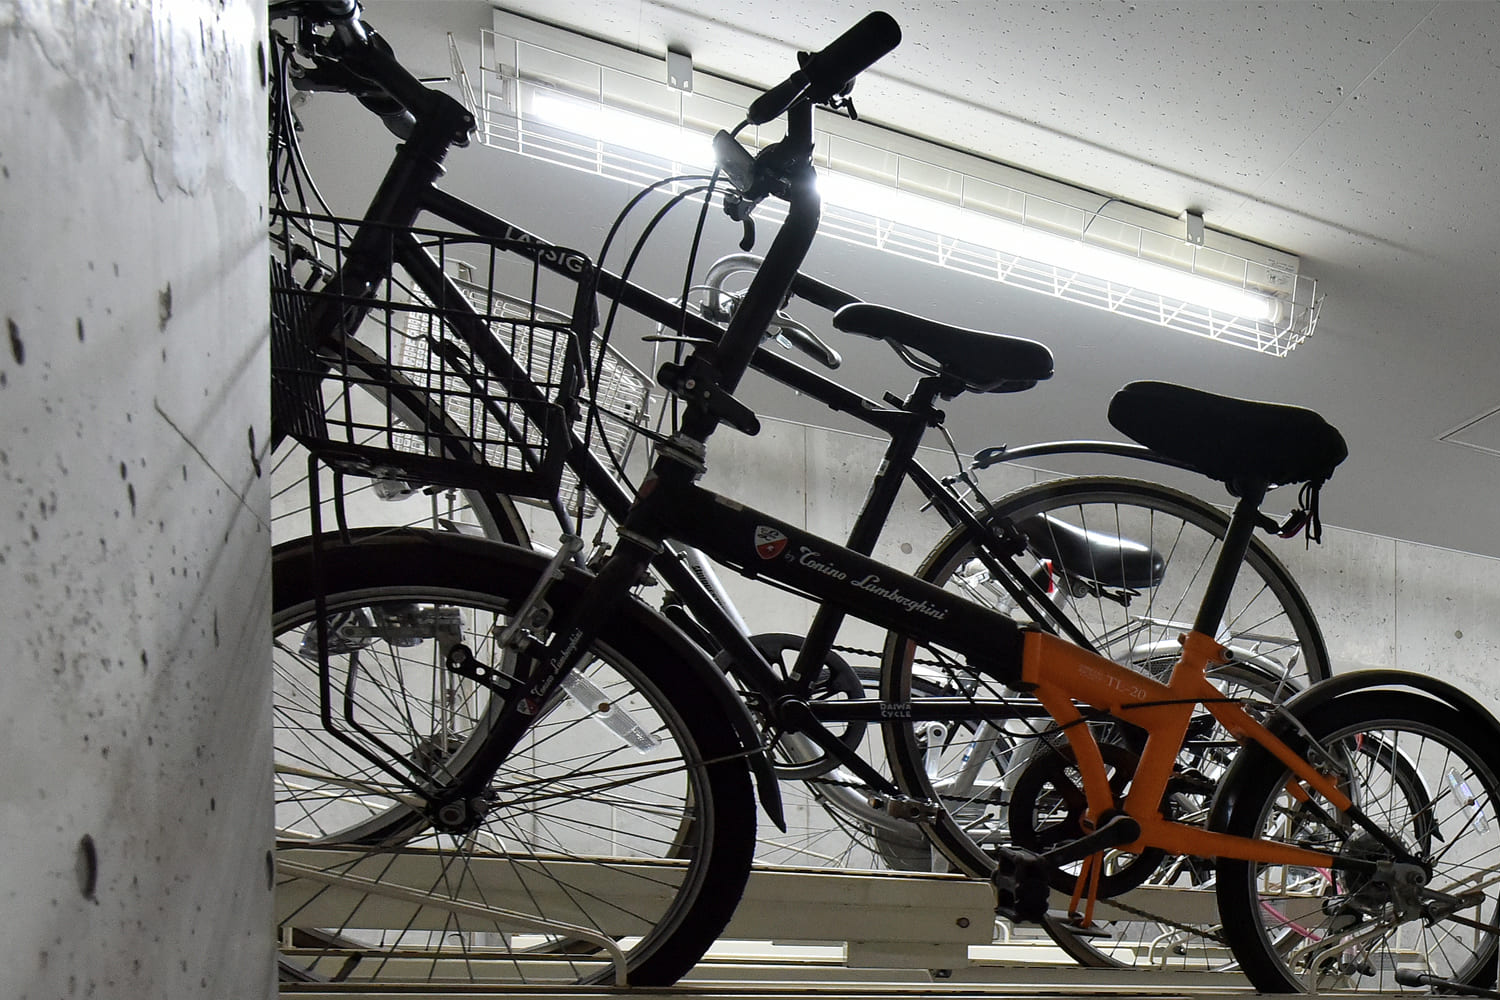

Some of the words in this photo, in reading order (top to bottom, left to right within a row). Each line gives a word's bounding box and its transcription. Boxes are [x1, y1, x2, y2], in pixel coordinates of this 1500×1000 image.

[799, 545, 847, 580] Tonino
[850, 574, 949, 620] Lamborghini
[880, 703, 911, 711] DAIWA
[881, 710, 912, 718] CYCLE
